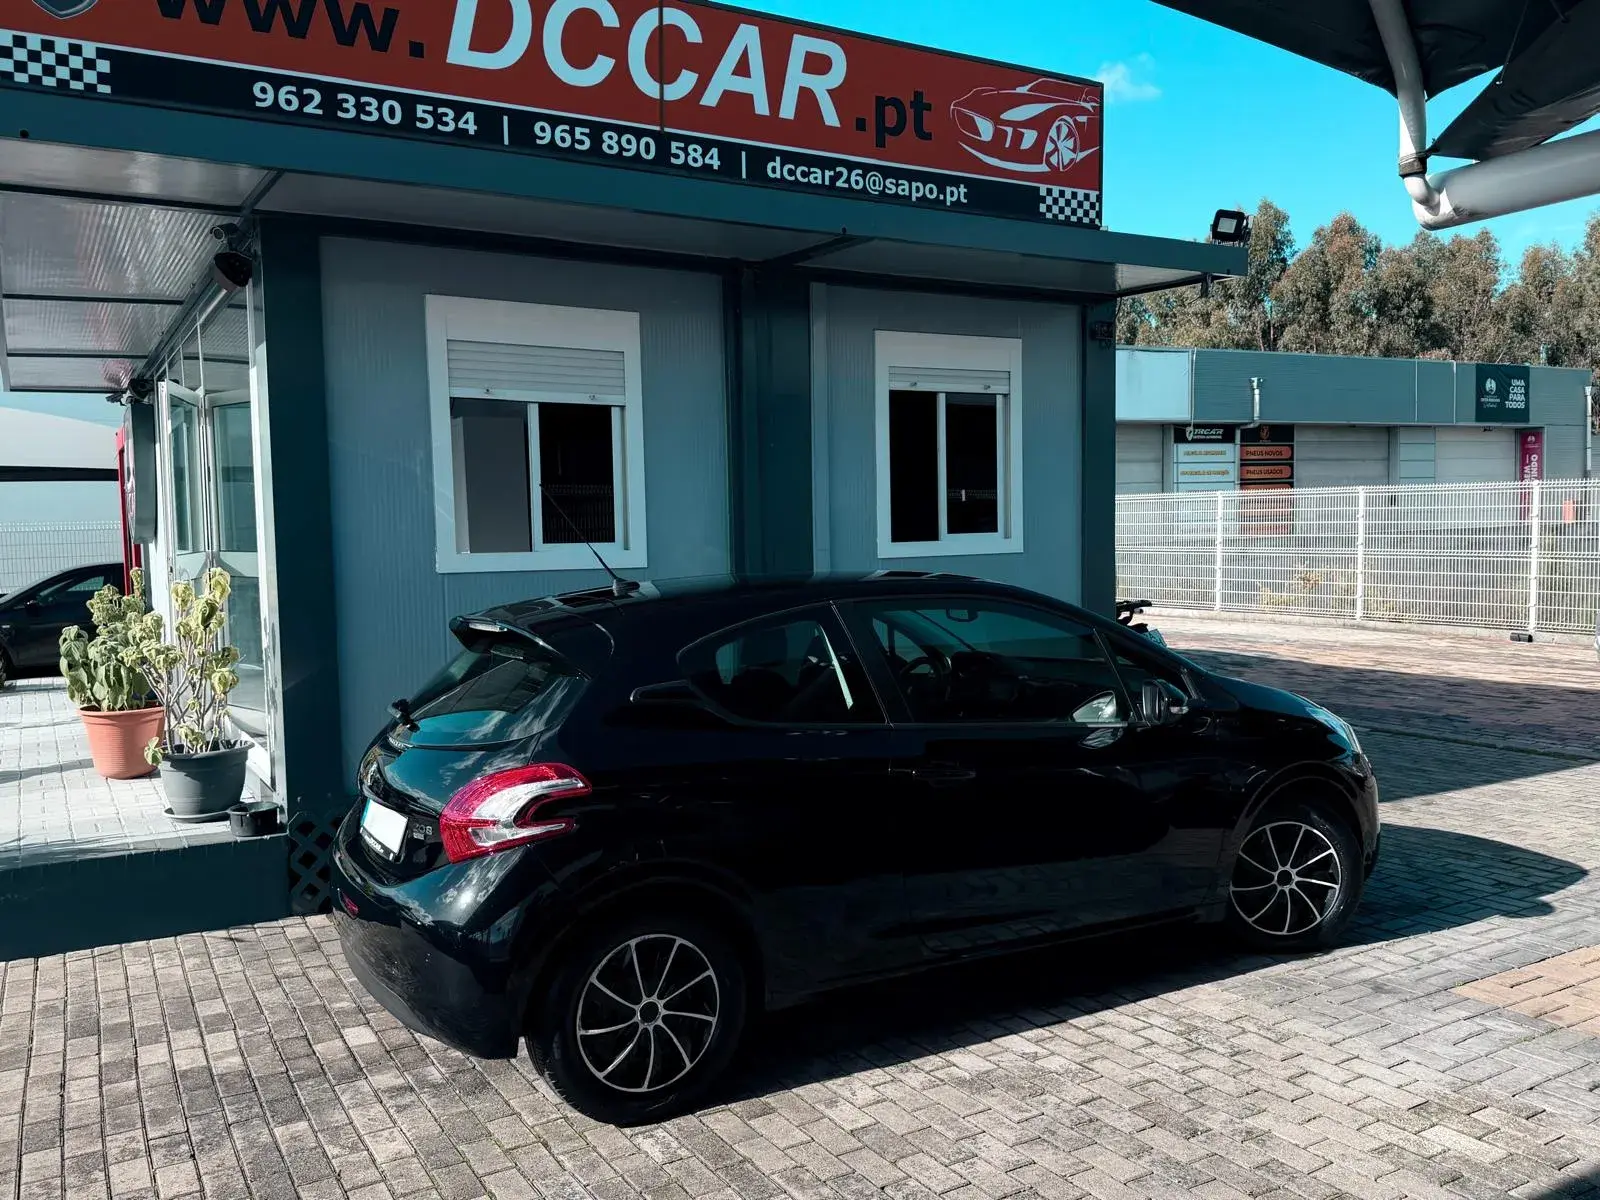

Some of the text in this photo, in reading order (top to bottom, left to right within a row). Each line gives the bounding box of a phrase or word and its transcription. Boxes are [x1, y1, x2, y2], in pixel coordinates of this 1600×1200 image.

[252, 81, 324, 115] 962
[336, 93, 402, 125] 330
[415, 104, 478, 135] 534
[533, 121, 591, 151] 965
[601, 131, 656, 160] 890
[670, 141, 721, 170] 584
[766, 156, 968, 205] dccar26@sapo.pt
[1509, 386, 1525, 394] CASA
[1509, 393, 1526, 402] PARA
[1505, 401, 1526, 409] TODOS
